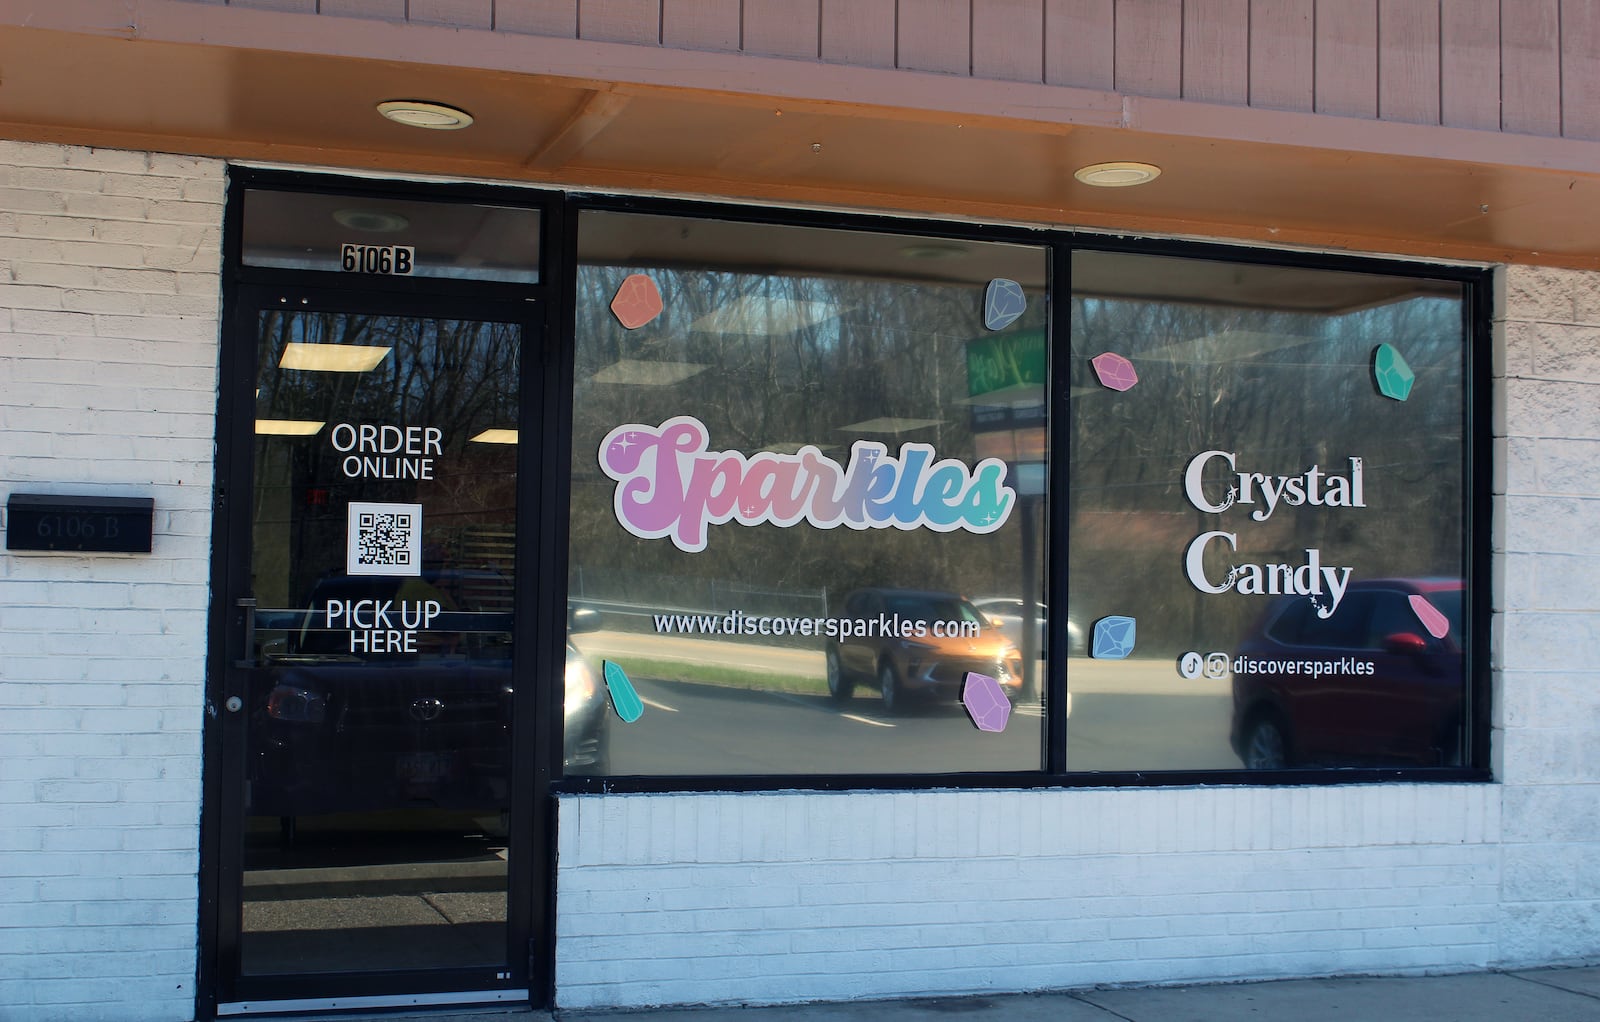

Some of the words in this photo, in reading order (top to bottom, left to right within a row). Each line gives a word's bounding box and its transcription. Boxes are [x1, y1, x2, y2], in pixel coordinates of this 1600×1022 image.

[342, 245, 411, 273] 6106B
[331, 424, 443, 456] ORDER
[342, 456, 434, 481] ONLINE
[600, 417, 1014, 551] Sparkles
[1184, 450, 1366, 522] Crystal
[37, 514, 96, 538] 6106
[104, 516, 119, 538] B
[1185, 530, 1353, 619] Candy
[325, 599, 392, 629] PICK
[401, 600, 441, 629] UP
[349, 630, 418, 653] HERE
[1233, 656, 1375, 679] discoversparkles
